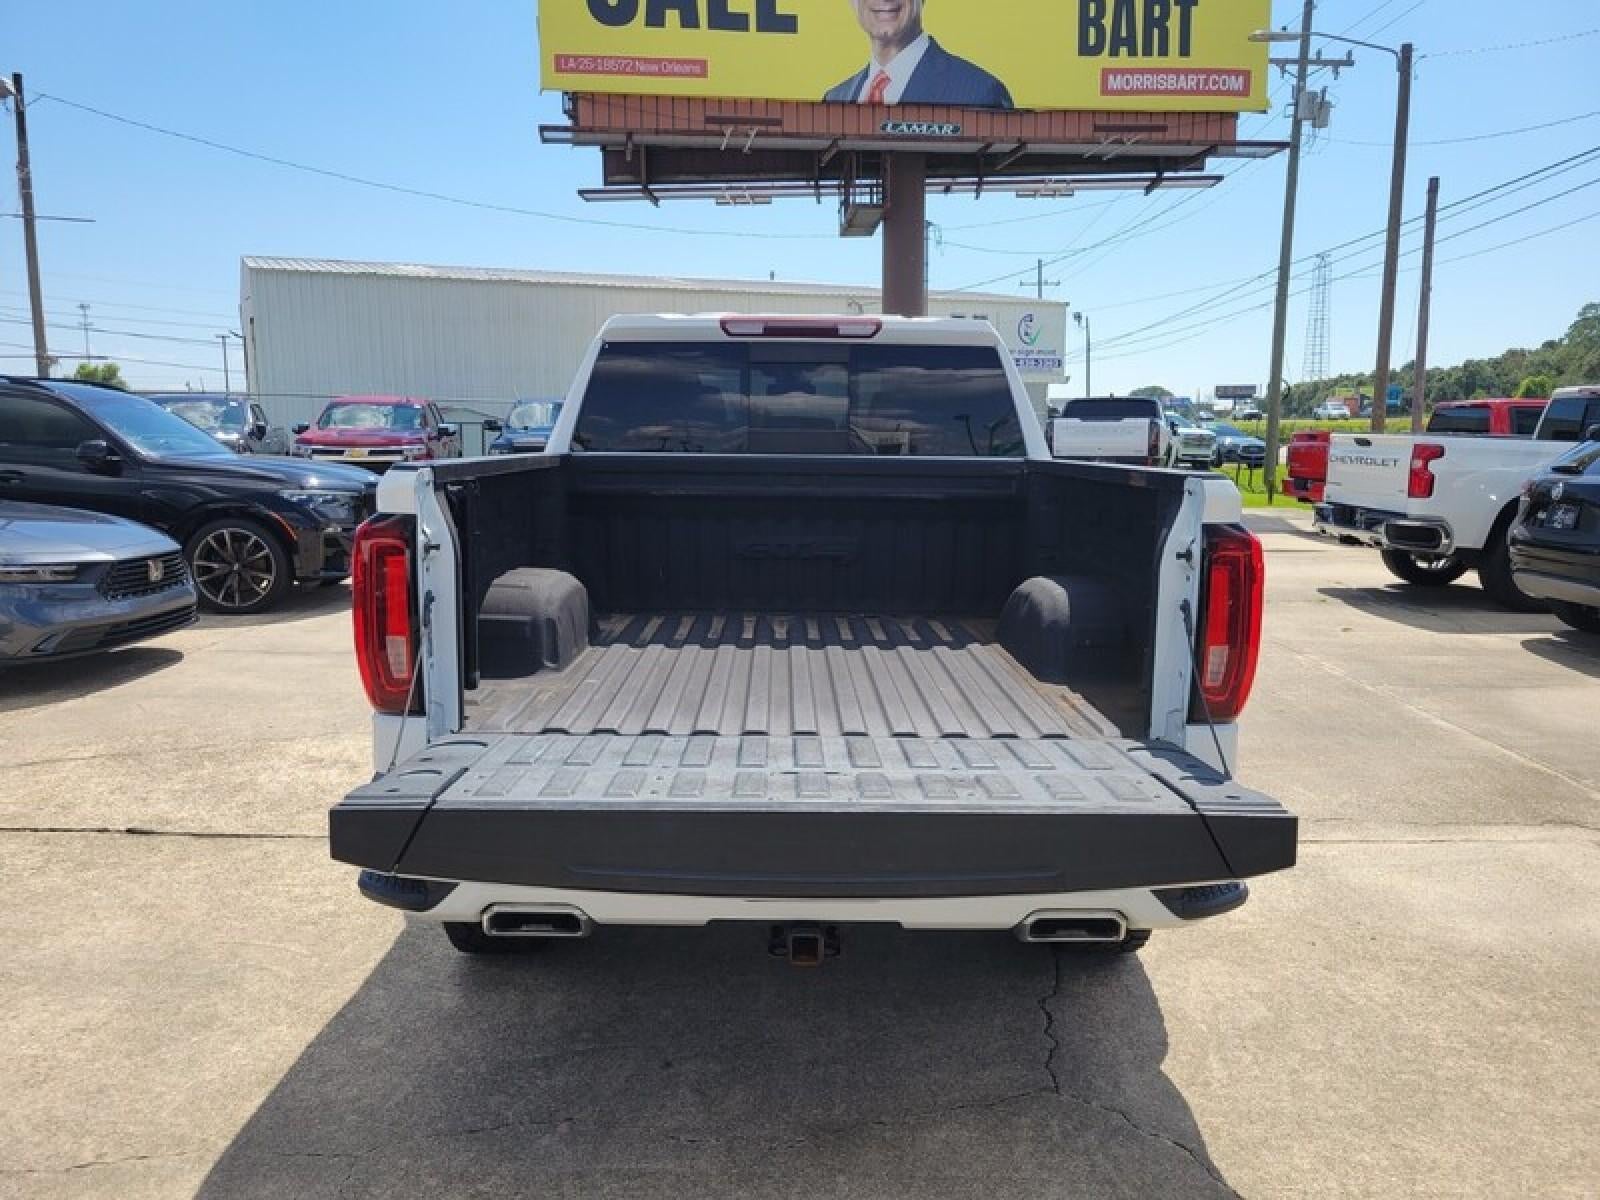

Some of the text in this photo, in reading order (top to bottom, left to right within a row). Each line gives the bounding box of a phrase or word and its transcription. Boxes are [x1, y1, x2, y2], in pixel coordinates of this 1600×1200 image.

[1077, 0, 1198, 57] BART
[636, 60, 658, 72] New
[662, 61, 701, 74] Orleans
[1107, 73, 1243, 92] MORRISBART.COM
[888, 122, 952, 135] LAMAR
[1330, 455, 1399, 467] CHEVROLET
